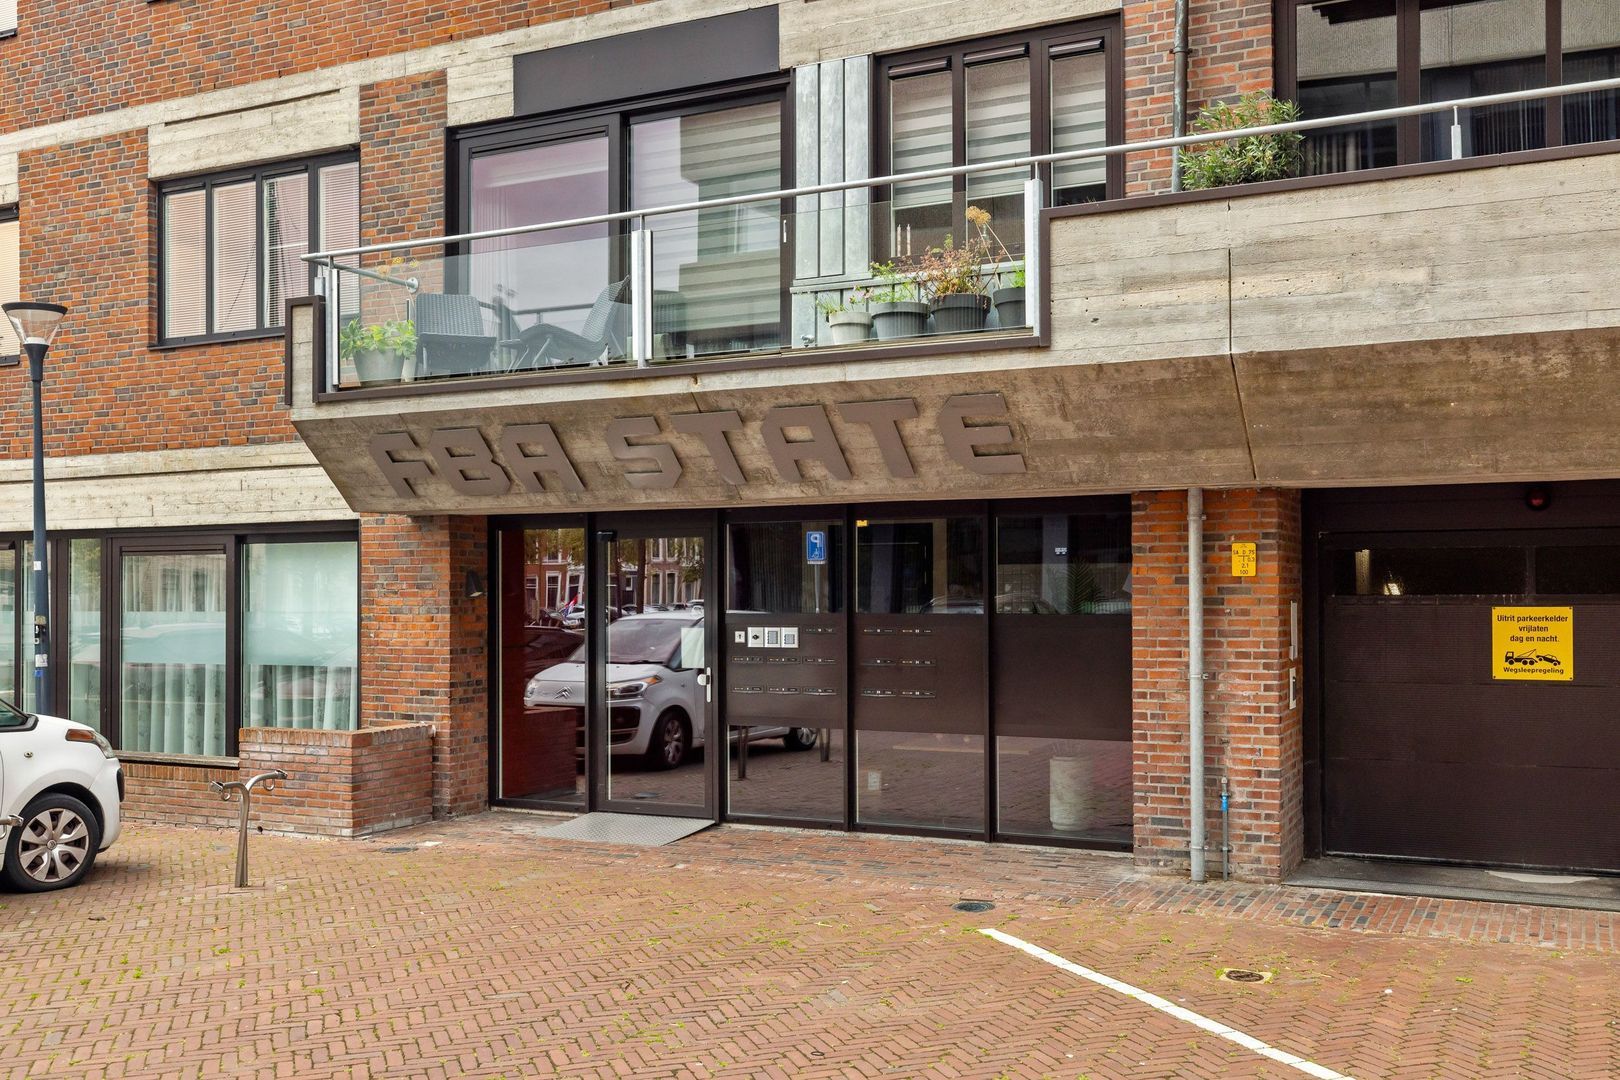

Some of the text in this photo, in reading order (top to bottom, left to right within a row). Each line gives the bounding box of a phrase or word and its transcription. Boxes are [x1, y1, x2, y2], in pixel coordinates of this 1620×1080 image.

[606, 392, 1028, 490] STATE
[1497, 614, 1568, 623] Uitrit parkeerkelder
